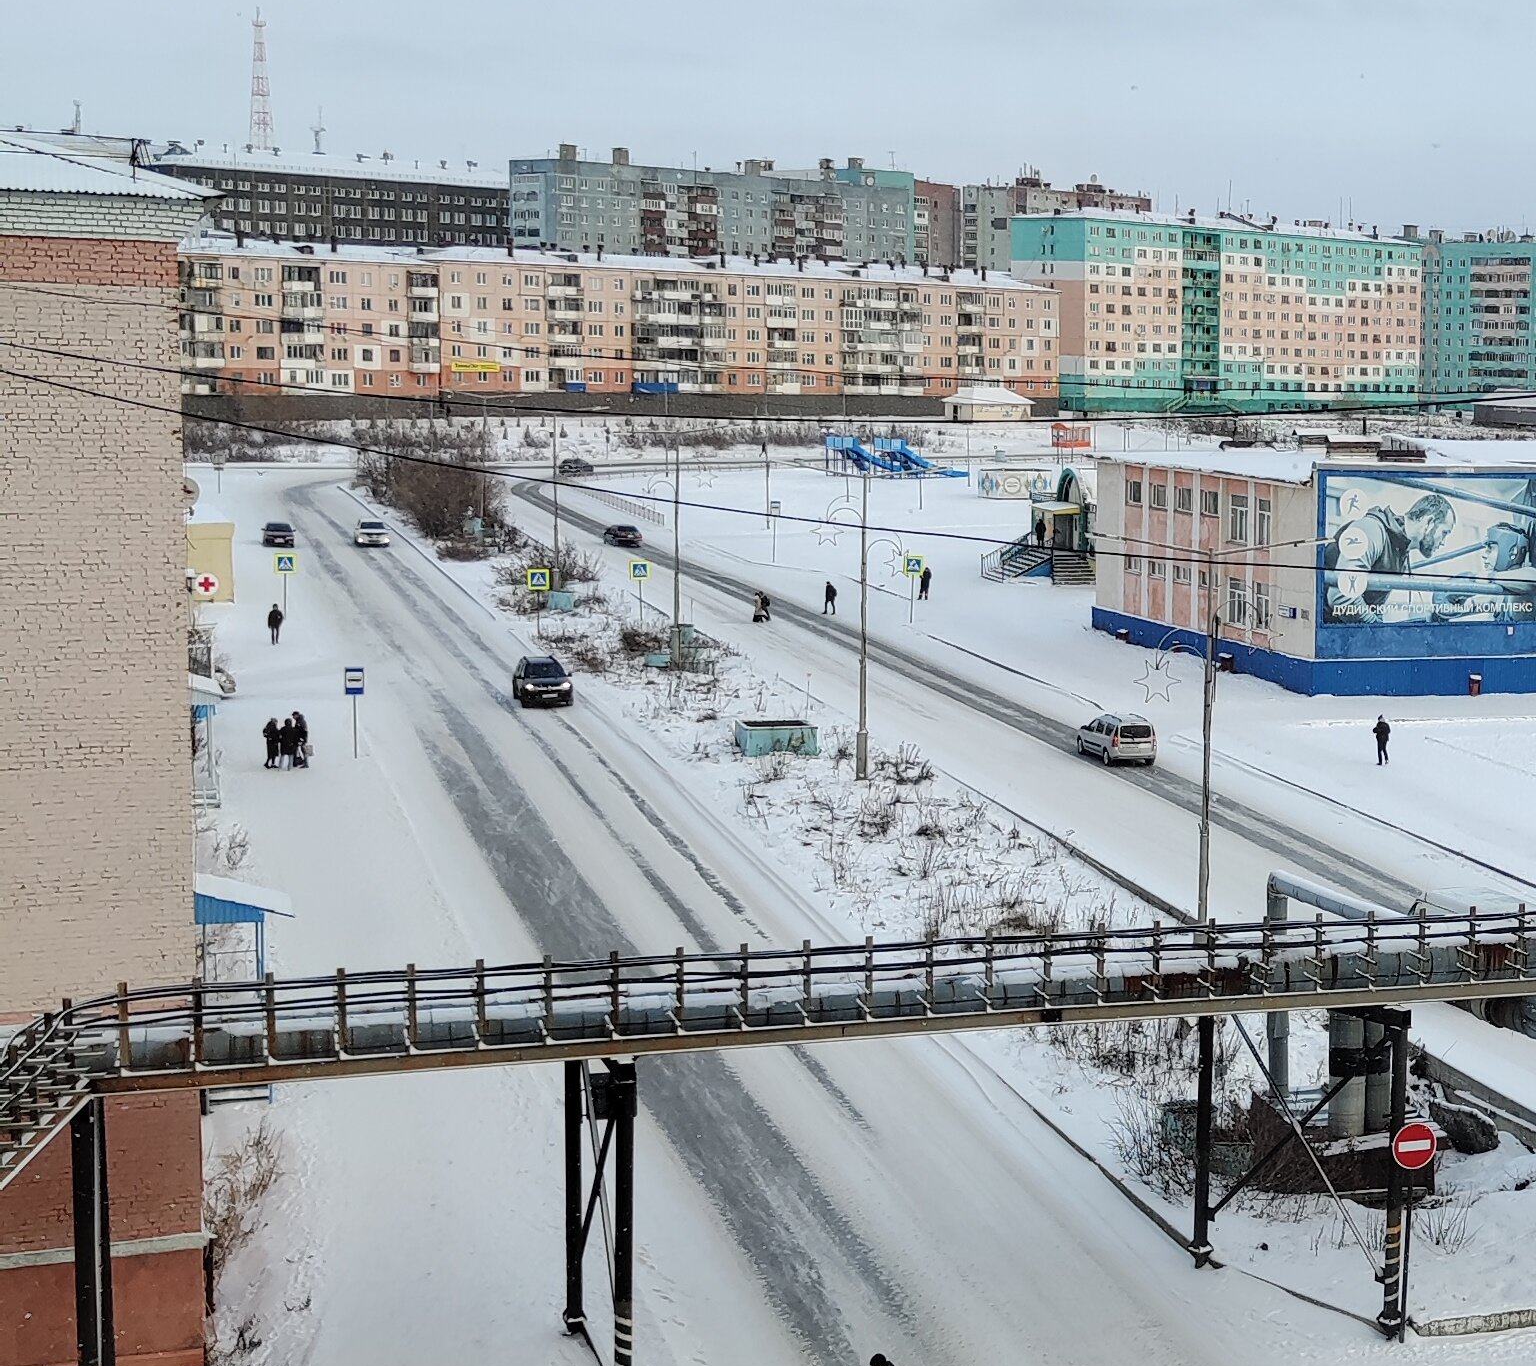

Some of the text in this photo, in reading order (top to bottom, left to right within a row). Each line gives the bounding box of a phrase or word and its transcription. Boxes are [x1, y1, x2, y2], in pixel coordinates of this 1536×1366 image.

[1332, 602, 1534, 616] ДУДИНСКИЙ СПОРТИВНЫЙ КОМПЛЕКС
